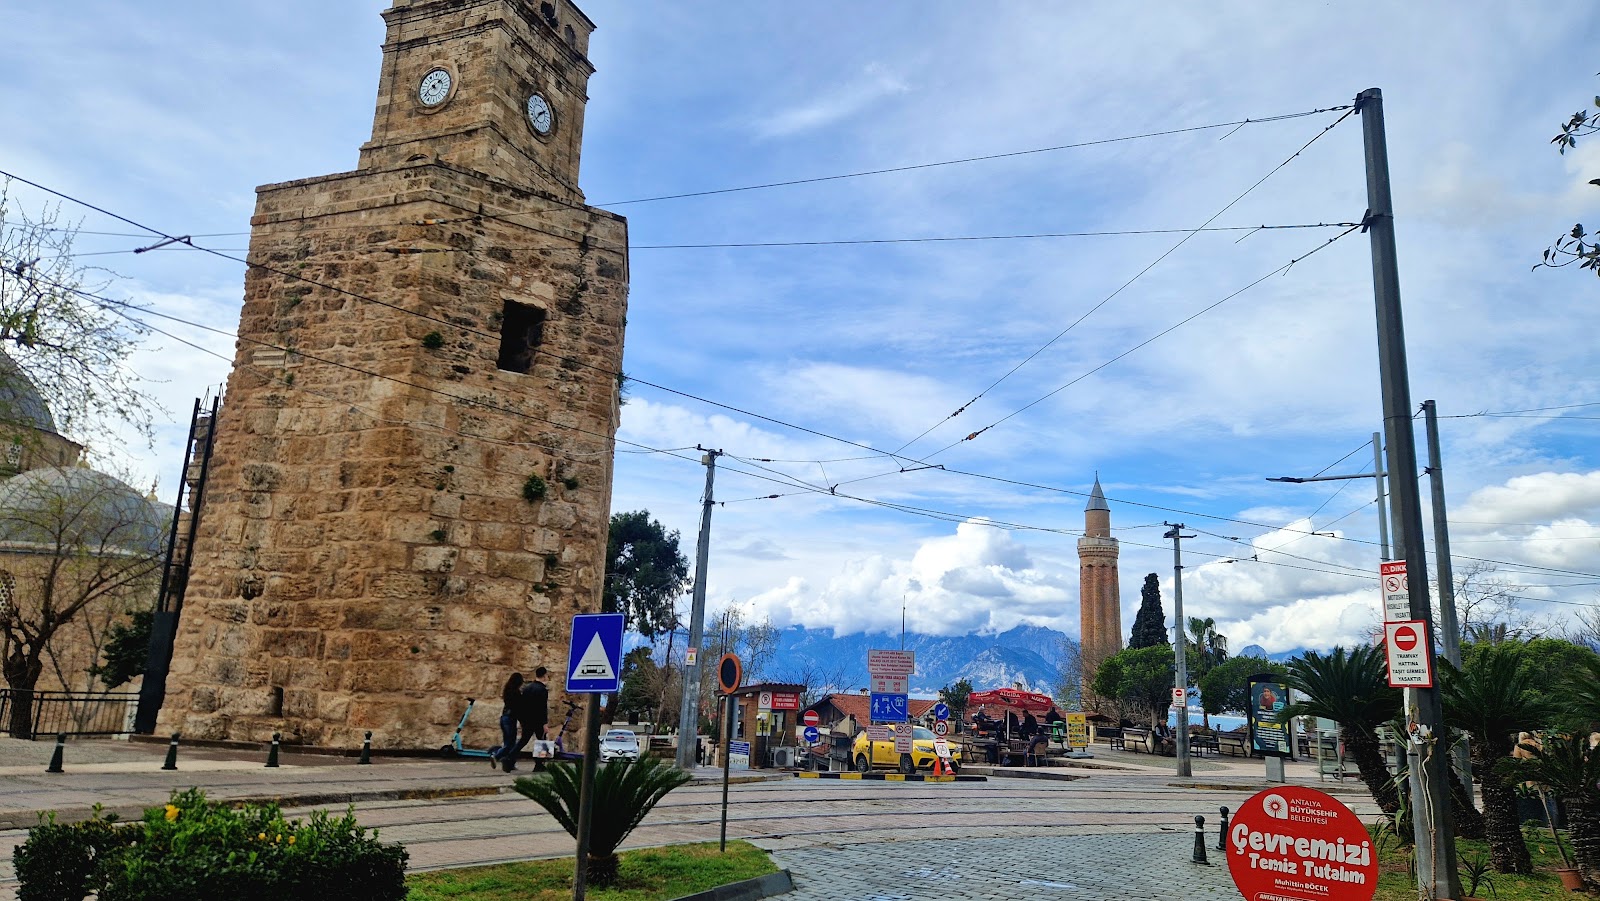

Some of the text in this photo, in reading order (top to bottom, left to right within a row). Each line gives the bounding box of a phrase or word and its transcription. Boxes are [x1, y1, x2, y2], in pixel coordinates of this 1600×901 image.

[1389, 564, 1407, 573] DİKK
[937, 724, 945, 733] 20
[1290, 798, 1322, 808] ANTALYA
[1290, 806, 1338, 818] BÜYÜKŞEHİR
[1290, 814, 1328, 825] BELEDİYESİ
[1231, 823, 1370, 866] Çevremizi
[1249, 853, 1365, 884] Temiz Tutalım
[1274, 878, 1329, 892] Muhittin BÖCEK
